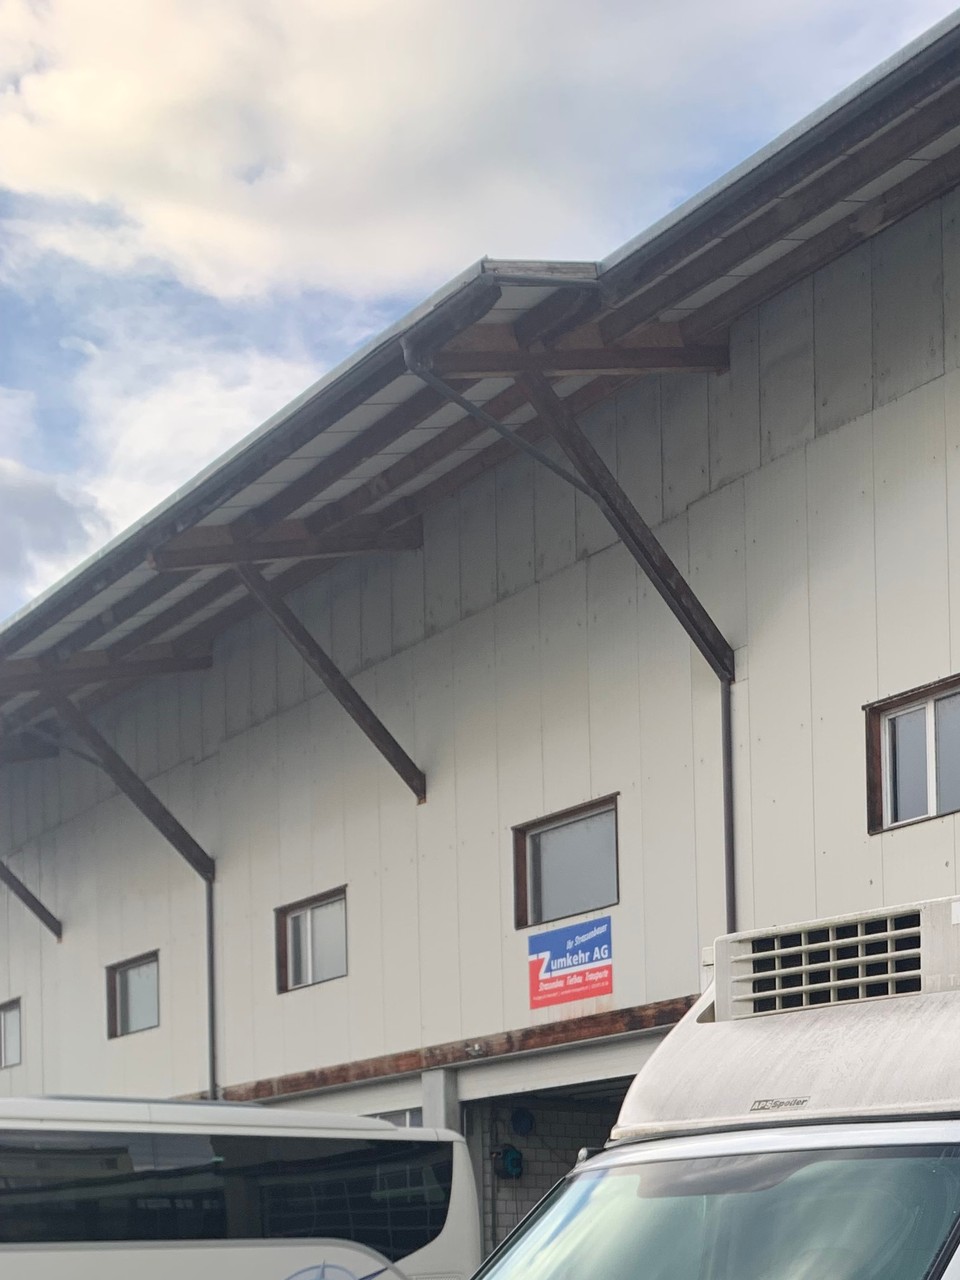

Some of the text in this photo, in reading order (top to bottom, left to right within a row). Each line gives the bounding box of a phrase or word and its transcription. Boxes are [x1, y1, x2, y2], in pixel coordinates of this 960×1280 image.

[538, 944, 609, 980] Zumkehr AG
[772, 1099, 808, 1109] Spoiler
